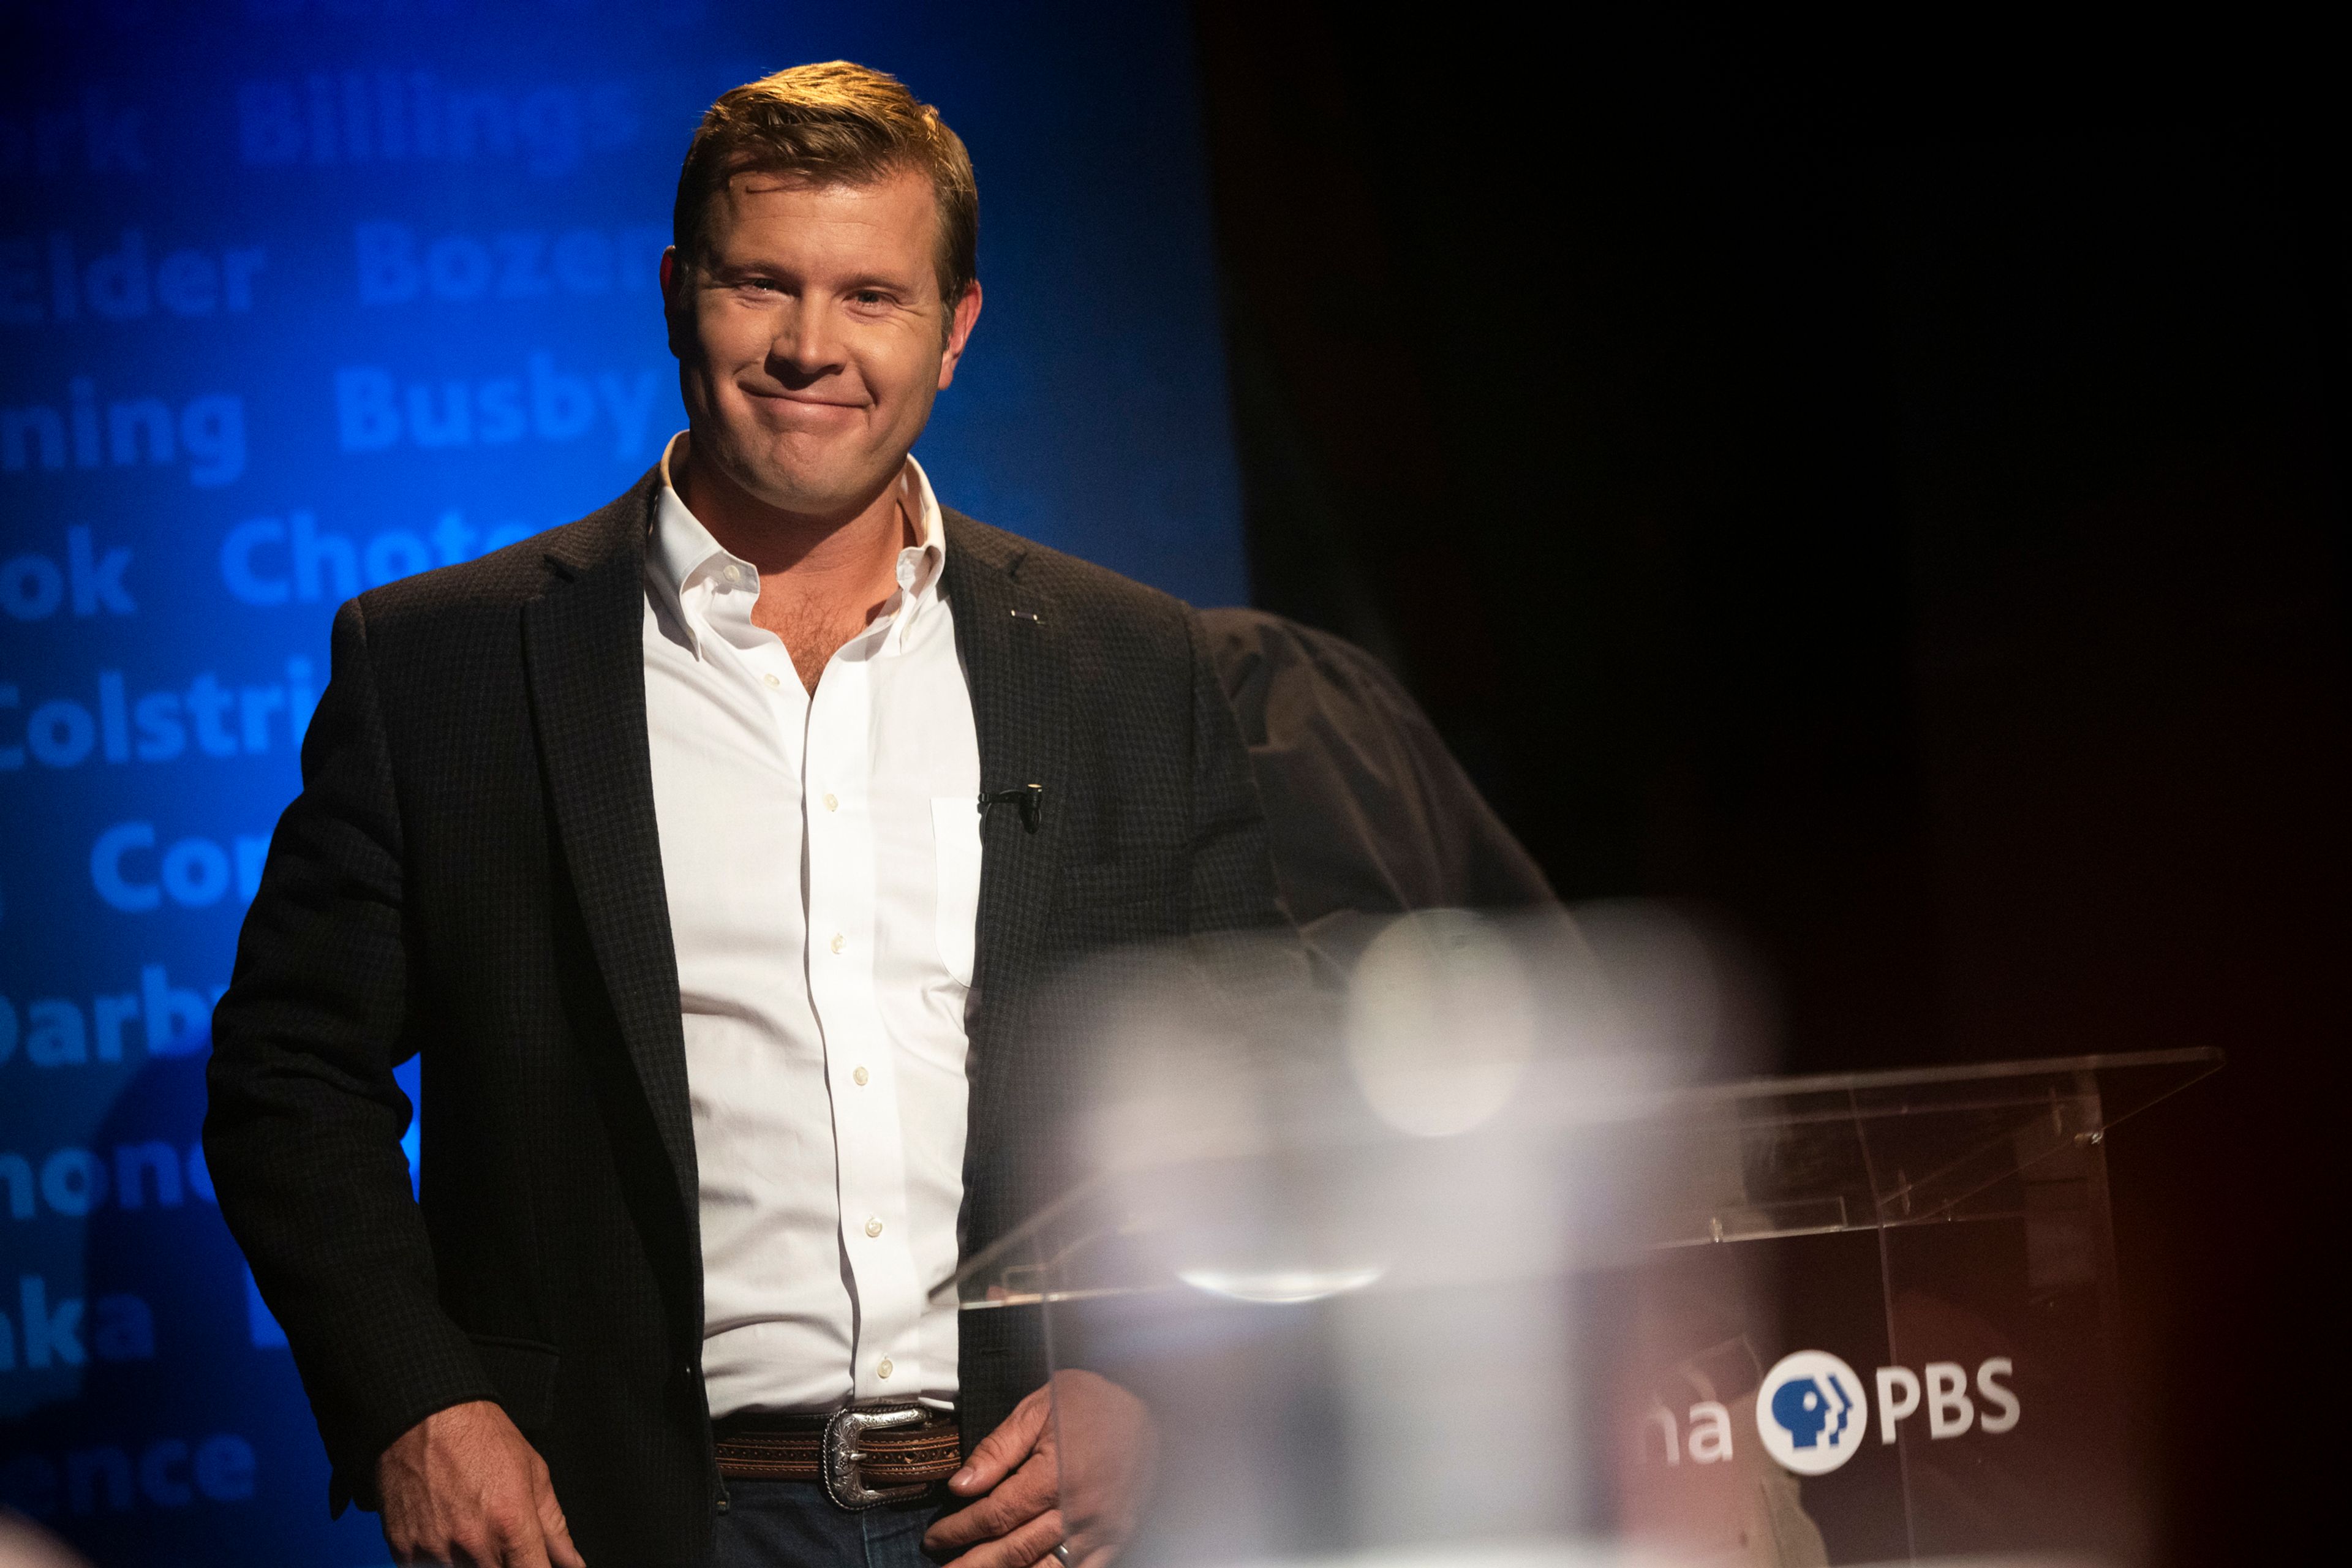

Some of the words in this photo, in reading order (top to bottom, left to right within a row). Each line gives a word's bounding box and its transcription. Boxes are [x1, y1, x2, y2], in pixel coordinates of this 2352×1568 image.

[236, 69, 641, 178] Billings
[334, 349, 659, 462] Busby
[1875, 1356, 2021, 1446] PBS
